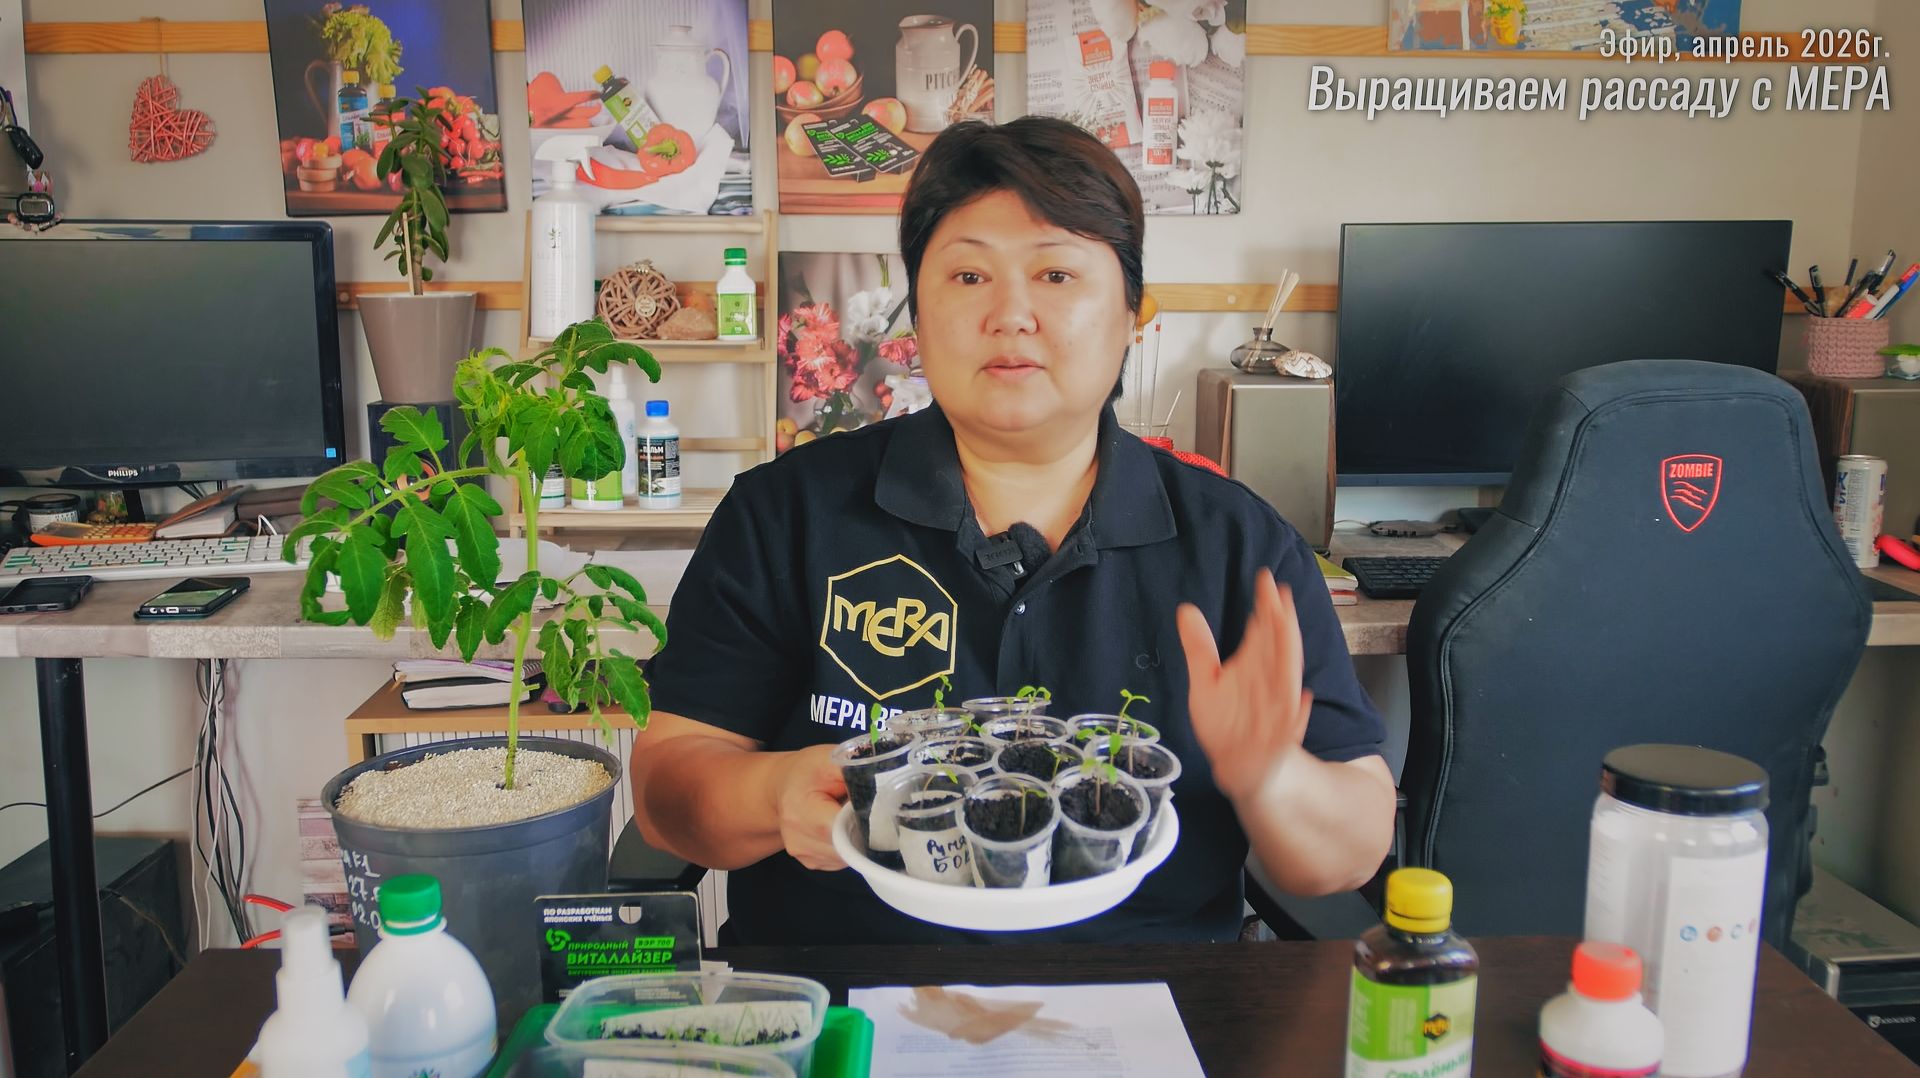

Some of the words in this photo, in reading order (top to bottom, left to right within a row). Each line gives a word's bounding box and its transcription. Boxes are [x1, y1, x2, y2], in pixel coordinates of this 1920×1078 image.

[107, 469, 139, 478] PHILIPS
[1669, 463, 1714, 478] ZOMBIE
[810, 693, 866, 731] МЕРА
[568, 939, 628, 951] ПРИРОДНЫЙ
[567, 950, 672, 965] ВИТАЛАЙЗЕР
